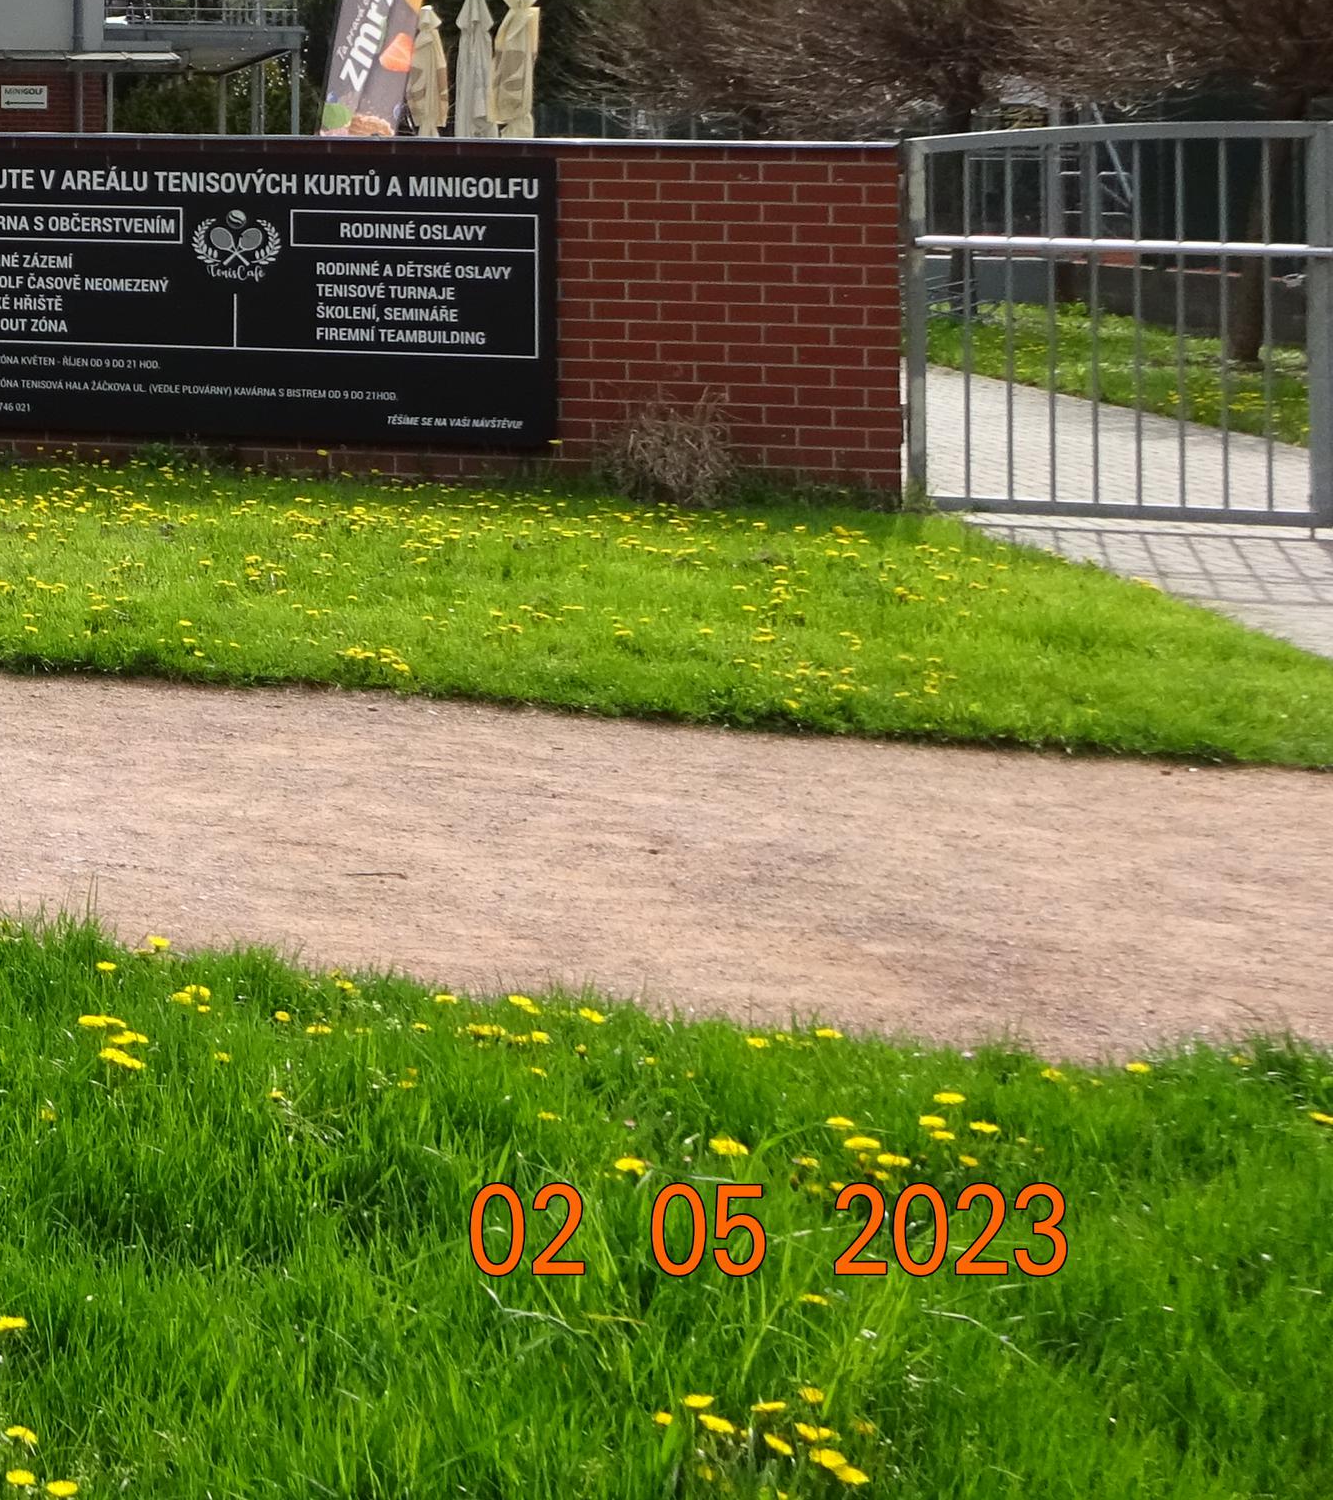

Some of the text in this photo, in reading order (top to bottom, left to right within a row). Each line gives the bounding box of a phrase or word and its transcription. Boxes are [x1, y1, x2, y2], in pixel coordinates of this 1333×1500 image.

[40, 169, 56, 190] V
[61, 165, 149, 192] AREÁLU
[154, 168, 298, 195] TENISOVÝCH
[304, 169, 380, 196] KURTŮ
[386, 176, 402, 197] A
[408, 176, 539, 199] MINIGOLFU
[33, 216, 44, 231] S
[48, 213, 175, 234] OBČERSTVENÍM
[340, 220, 487, 241] RODINNÉ OSLAVY
[22, 252, 73, 269] ZÁZEMÍ
[316, 260, 512, 280] RODINNÉ A DĚTSKÉ OSLAVY
[27, 273, 82, 291] ČASOVĚ
[84, 276, 169, 292] NEOMEZENÝ
[316, 283, 455, 300] TENISOVÉ TURNAJE
[13, 294, 63, 311] HŘIŠTĚ
[316, 302, 459, 322] ŠKOLENÍ, SEMINÁŘE
[0, 318, 27, 332] OUT
[30, 316, 68, 333] ZÓNA
[316, 326, 486, 345] FIREMNÍ TEAMBUILDING
[21, 355, 55, 366] KVĚTEN
[62, 356, 88, 367] ŘÍJEN
[90, 358, 103, 368] OD
[104, 359, 111, 368] 9
[112, 359, 125, 368] DO
[126, 359, 136, 369] 21
[139, 360, 160, 369] HOD.
[21, 379, 64, 390] TENISOVÁ
[65, 381, 89, 390] HALA
[91, 380, 131, 392] ŽÁČKOVA
[149, 383, 180, 395] (VEDLE
[182, 385, 232, 397] PLOVÁRNY)
[233, 386, 276, 397] KAVÁRNA
[278, 388, 285, 397] S
[287, 388, 326, 399] BISTREM
[328, 390, 341, 399] OD
[343, 390, 349, 399] 9
[351, 391, 364, 400] DO
[15, 403, 30, 412] 021
[387, 413, 419, 426] TĚŠÍME
[421, 416, 433, 426] SE
[434, 417, 447, 427] NA
[449, 416, 471, 427] VAŠI
